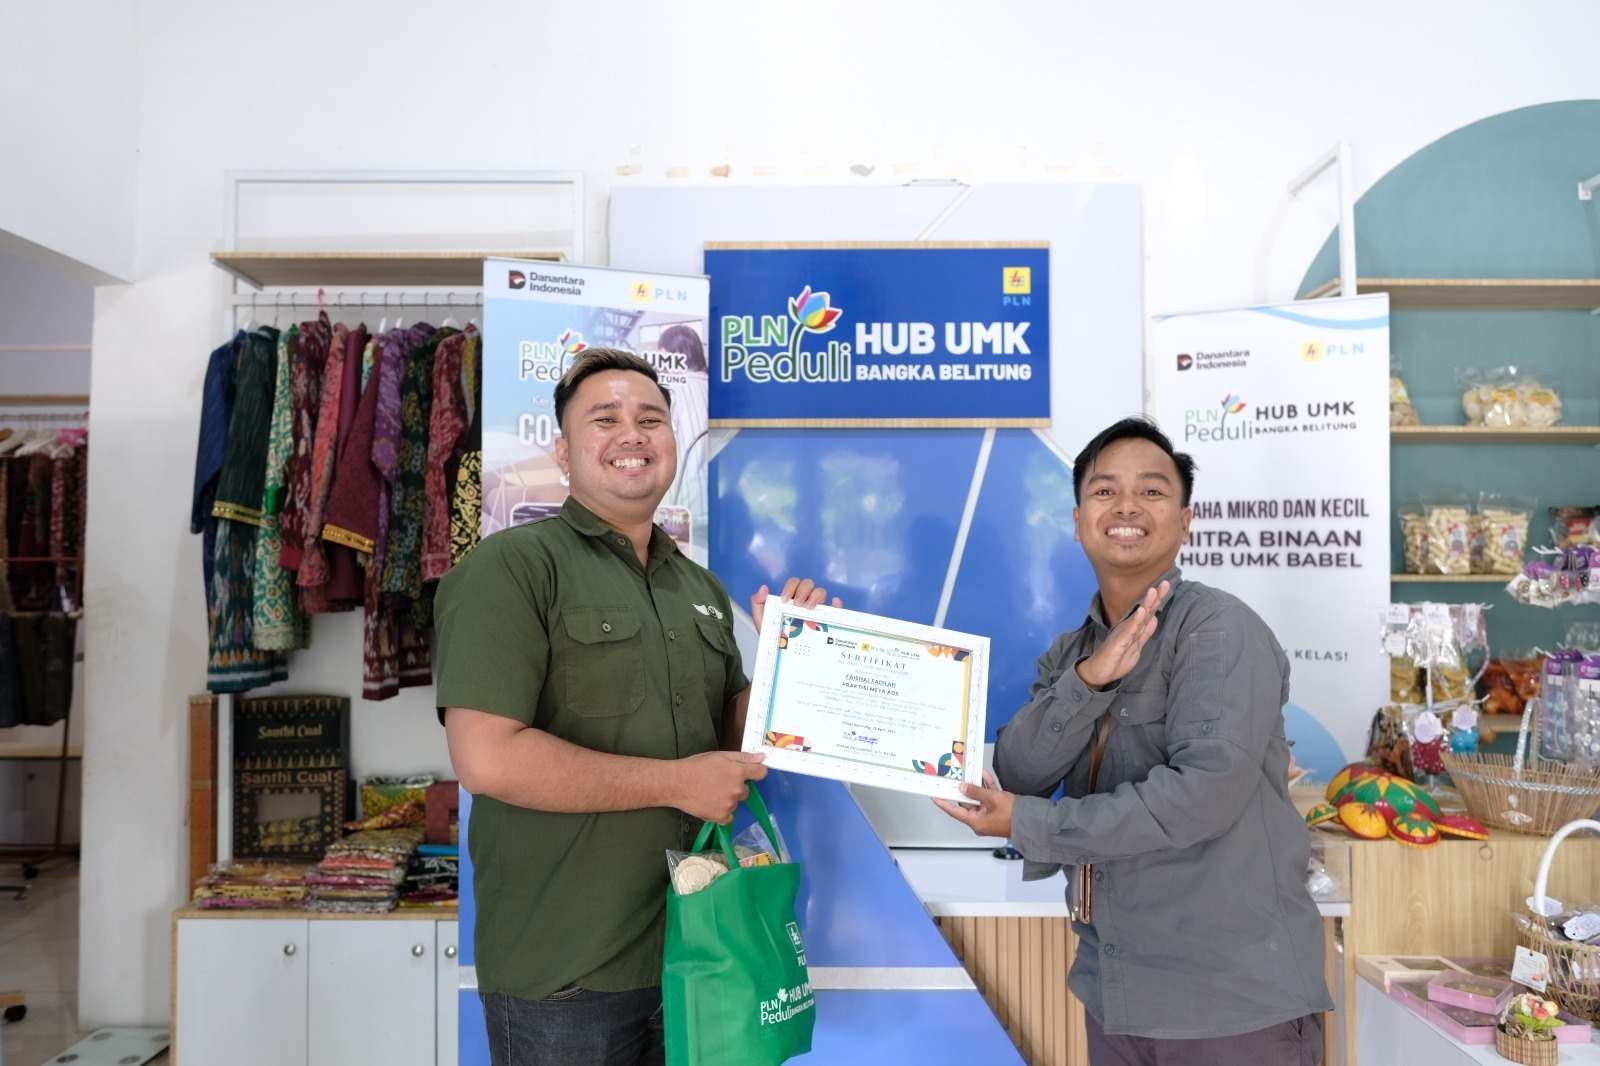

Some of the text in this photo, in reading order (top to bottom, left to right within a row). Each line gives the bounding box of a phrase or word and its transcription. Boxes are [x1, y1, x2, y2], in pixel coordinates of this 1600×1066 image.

[530, 271, 585, 286] Danantara
[530, 283, 582, 296] Indonesia
[654, 287, 688, 301] PLN
[1003, 295, 1031, 306] PLN
[722, 316, 787, 345] PLN
[855, 322, 1031, 355] HUB UMK
[522, 343, 557, 360] PLN
[1196, 350, 1250, 361] Danantara
[1326, 343, 1365, 356] PLN
[722, 341, 851, 382] Peduli
[1196, 359, 1247, 371] Indonesia
[522, 359, 563, 381] Ped
[856, 364, 1032, 381] BANGKA BELITUNG
[1185, 408, 1219, 424] PLN
[1256, 401, 1356, 421] HUB UMK
[1185, 420, 1253, 442] Peduli
[1255, 422, 1357, 436] BANGKA BELITUNG
[1192, 498, 1370, 519] AHA MIKRO DAN KECIL
[1259, 530, 1362, 548] BINAAN
[1180, 552, 1362, 568] HUB UMK BABEL
[841, 651, 907, 670] SERTIFIKAT
[1295, 649, 1348, 662] KELAS!
[842, 681, 899, 697] PRAKTISI META ADS
[258, 724, 322, 739] Santhi Cual
[241, 770, 332, 784] Santhi Cual
[789, 985, 802, 1003] HUB
[760, 999, 778, 1012] PLN
[761, 1005, 793, 1025] Peduli
